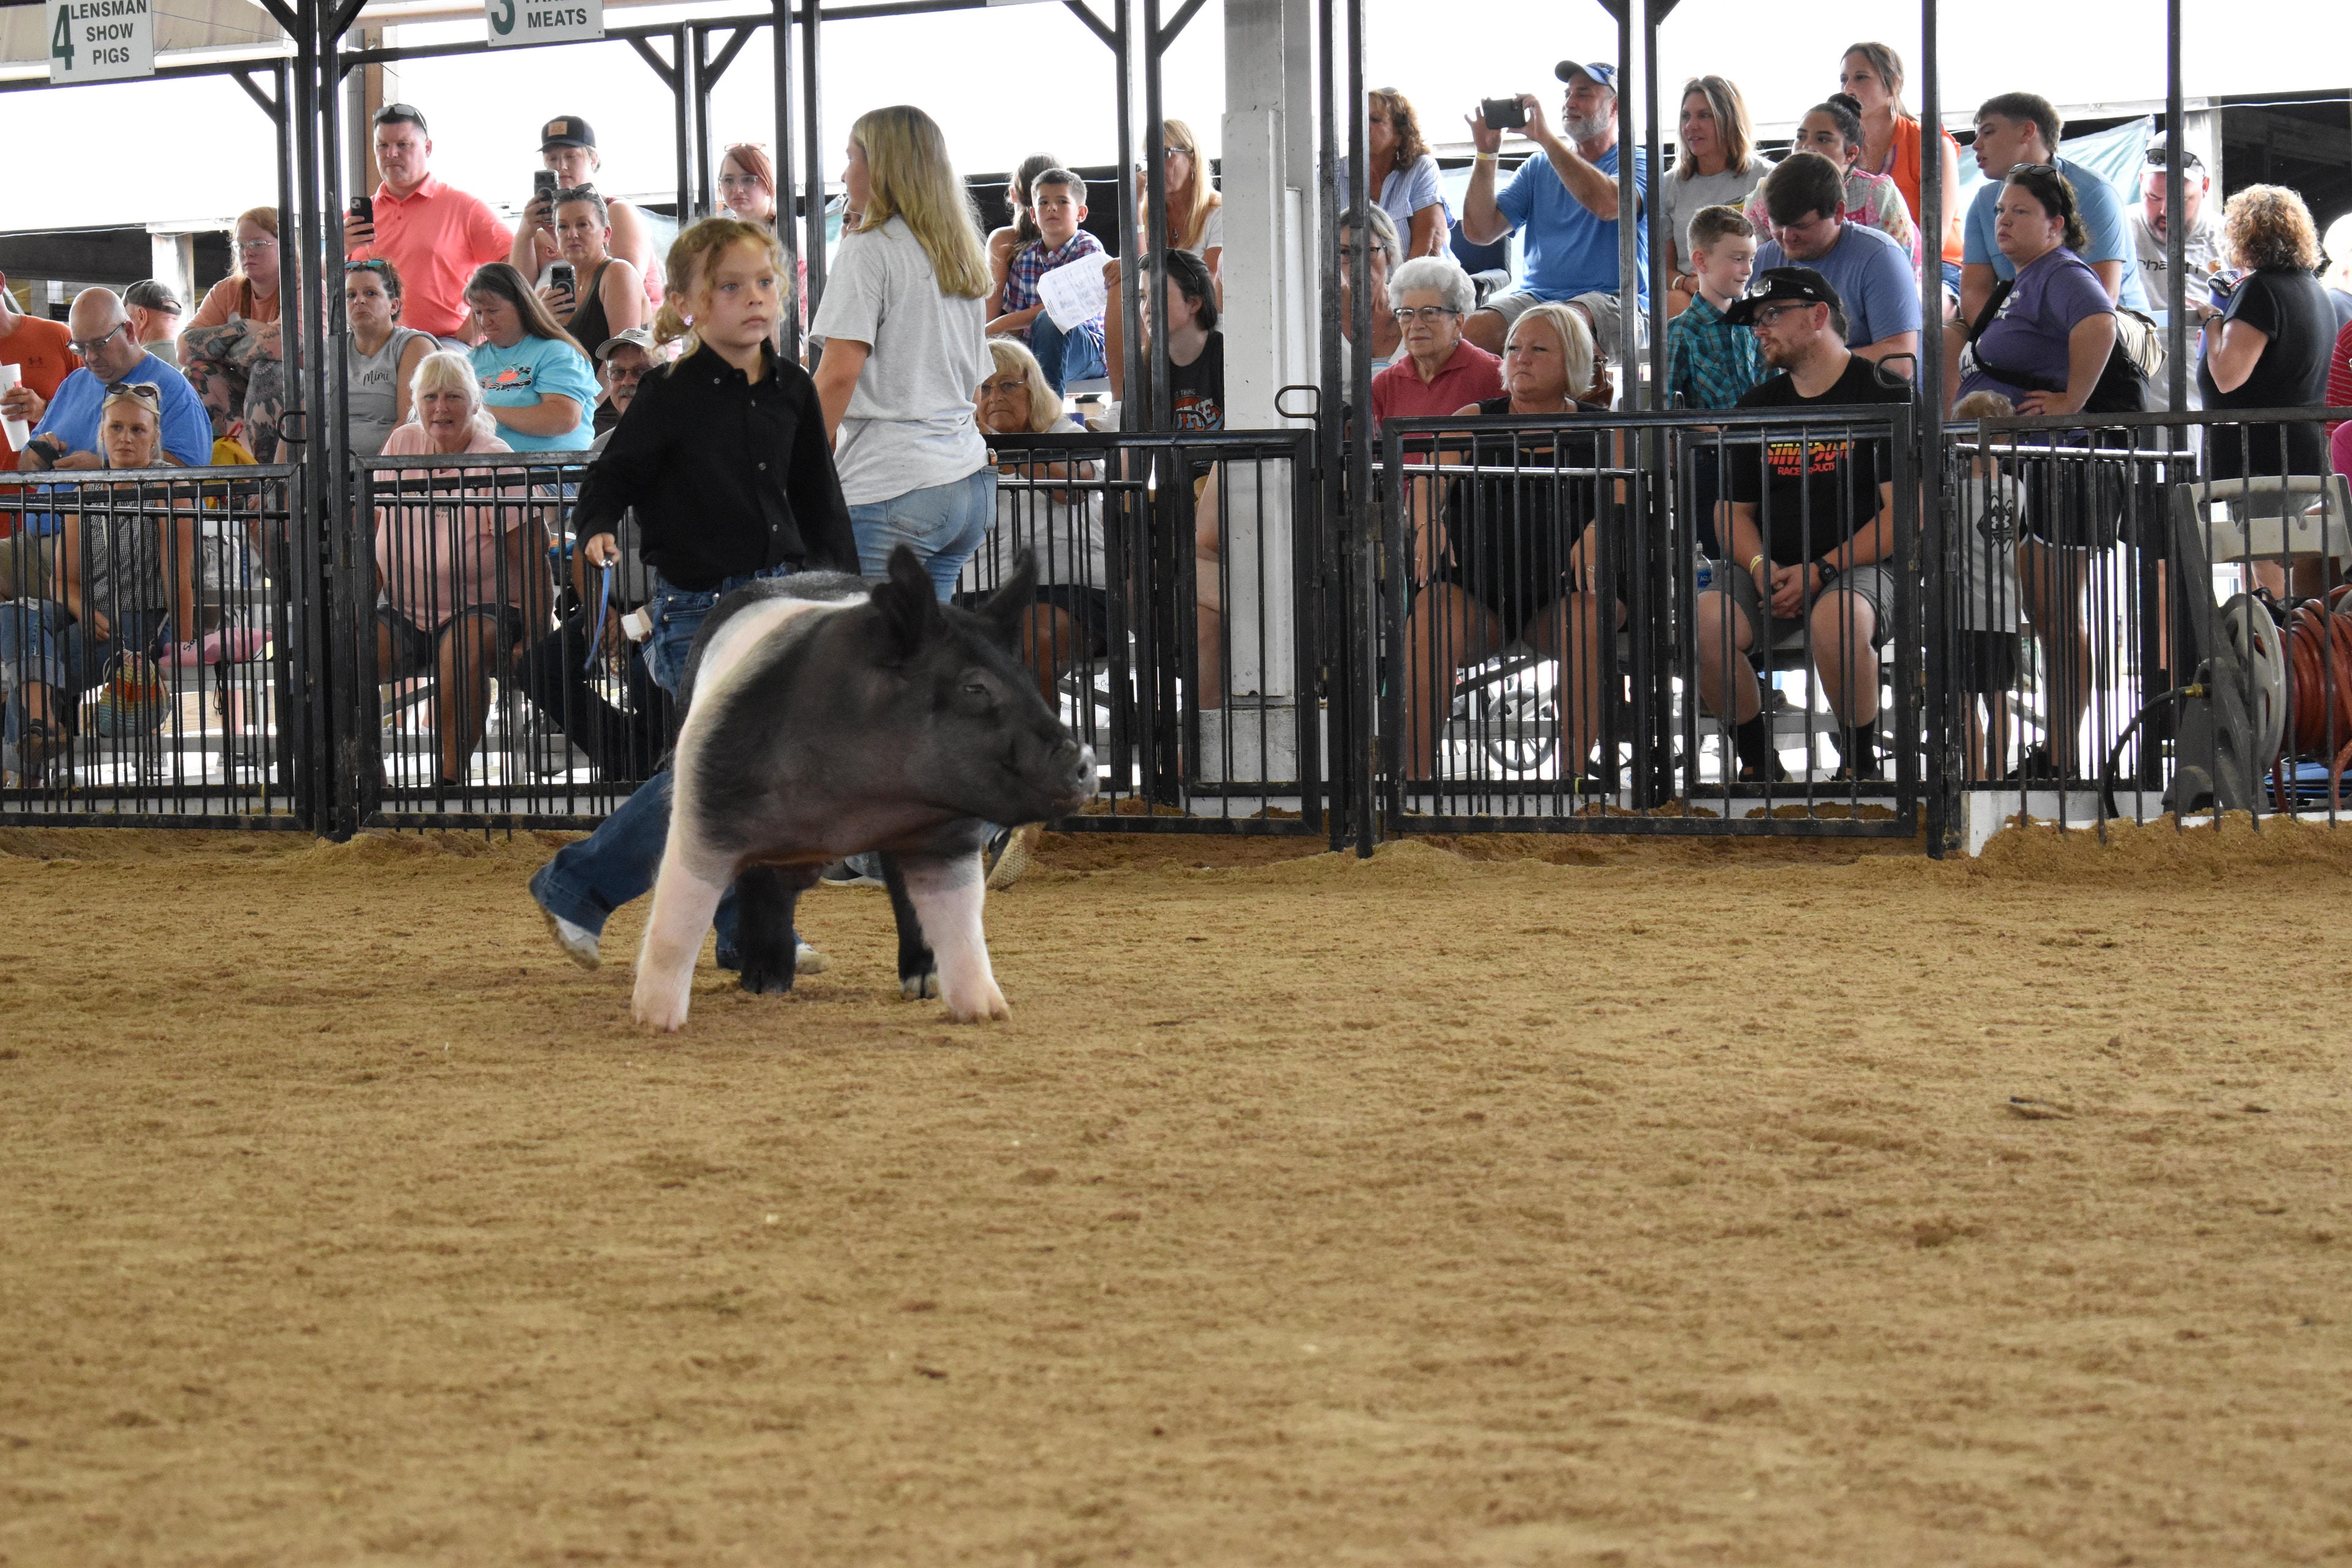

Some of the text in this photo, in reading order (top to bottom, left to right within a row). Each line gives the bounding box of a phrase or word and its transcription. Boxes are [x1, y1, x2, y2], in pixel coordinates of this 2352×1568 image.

[70, 0, 147, 20] LENSMAN
[527, 8, 587, 28] MEATS
[52, 4, 75, 70] 4
[86, 23, 134, 42] SHOW
[92, 47, 130, 65] PIGS
[363, 370, 389, 386] Mimi
